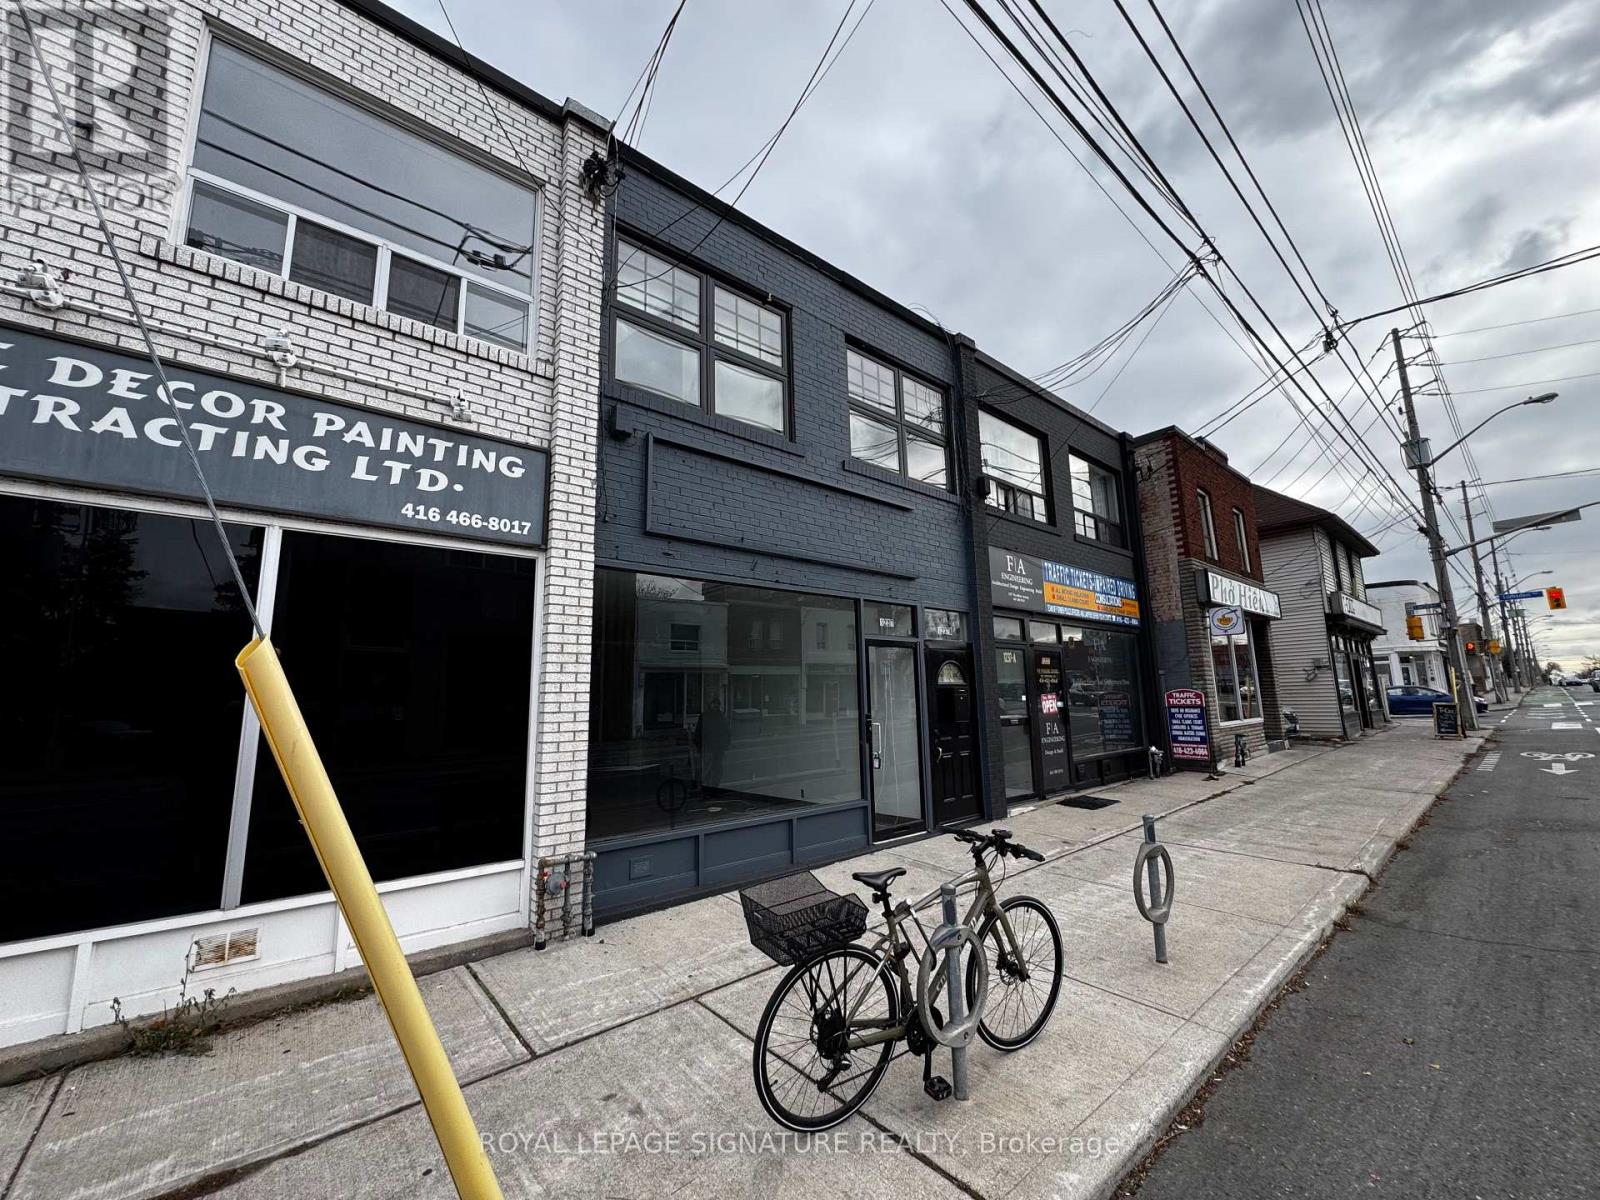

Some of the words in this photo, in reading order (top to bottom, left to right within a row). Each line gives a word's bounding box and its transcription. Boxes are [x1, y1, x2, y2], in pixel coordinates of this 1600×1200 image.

[47, 356, 287, 432] DECOR
[313, 412, 526, 478] PAINTING
[351, 456, 464, 492] LTD.
[401, 503, 441, 522] 416
[446, 510, 532, 535] 466-8017
[1042, 700, 1058, 714] OPEN
